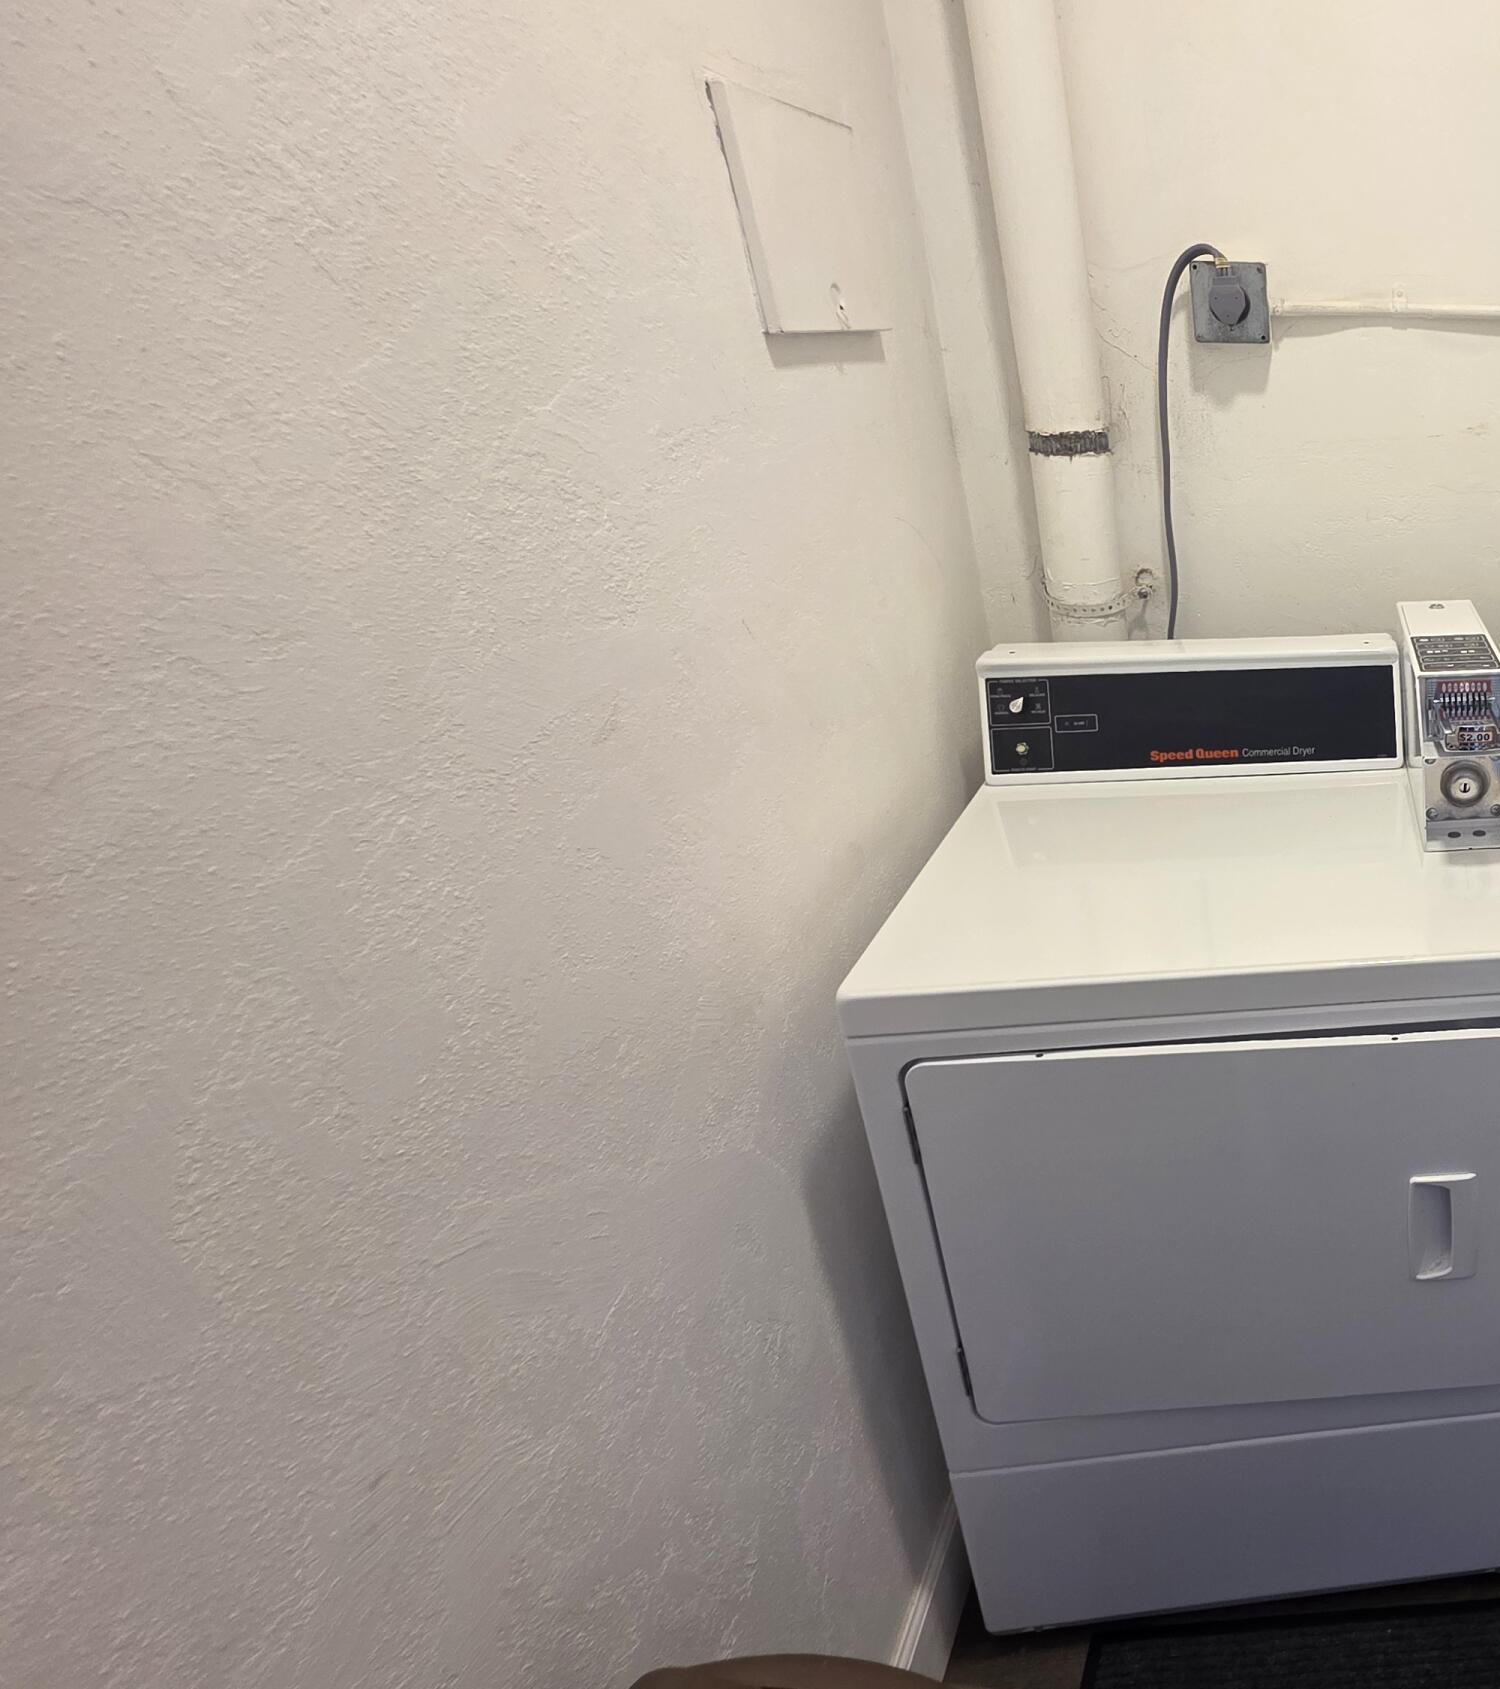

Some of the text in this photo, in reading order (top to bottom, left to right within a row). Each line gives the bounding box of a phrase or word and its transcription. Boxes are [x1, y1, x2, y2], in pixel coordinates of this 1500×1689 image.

[1459, 733, 1490, 742] $2.00
[1151, 746, 1316, 763] Speed Queen Commercial Dryer
